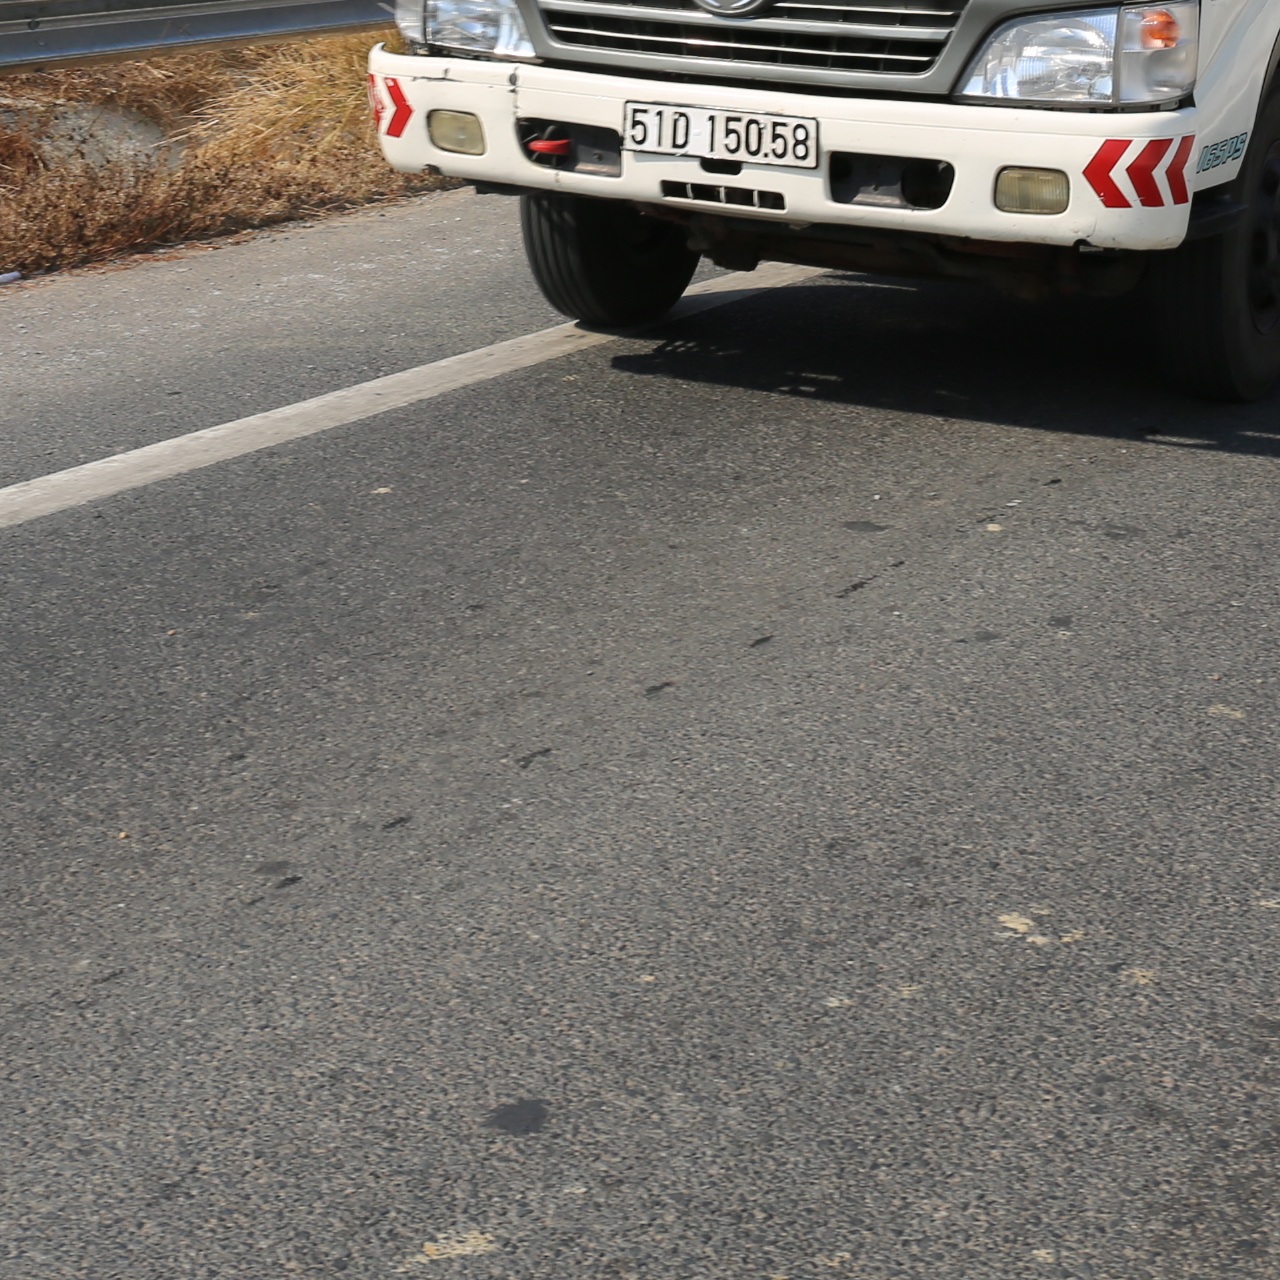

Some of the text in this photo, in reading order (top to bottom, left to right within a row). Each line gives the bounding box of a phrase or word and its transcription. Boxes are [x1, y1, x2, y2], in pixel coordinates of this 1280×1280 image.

[631, 107, 809, 161] 51D 150.58
[1196, 132, 1248, 174] 165PS
